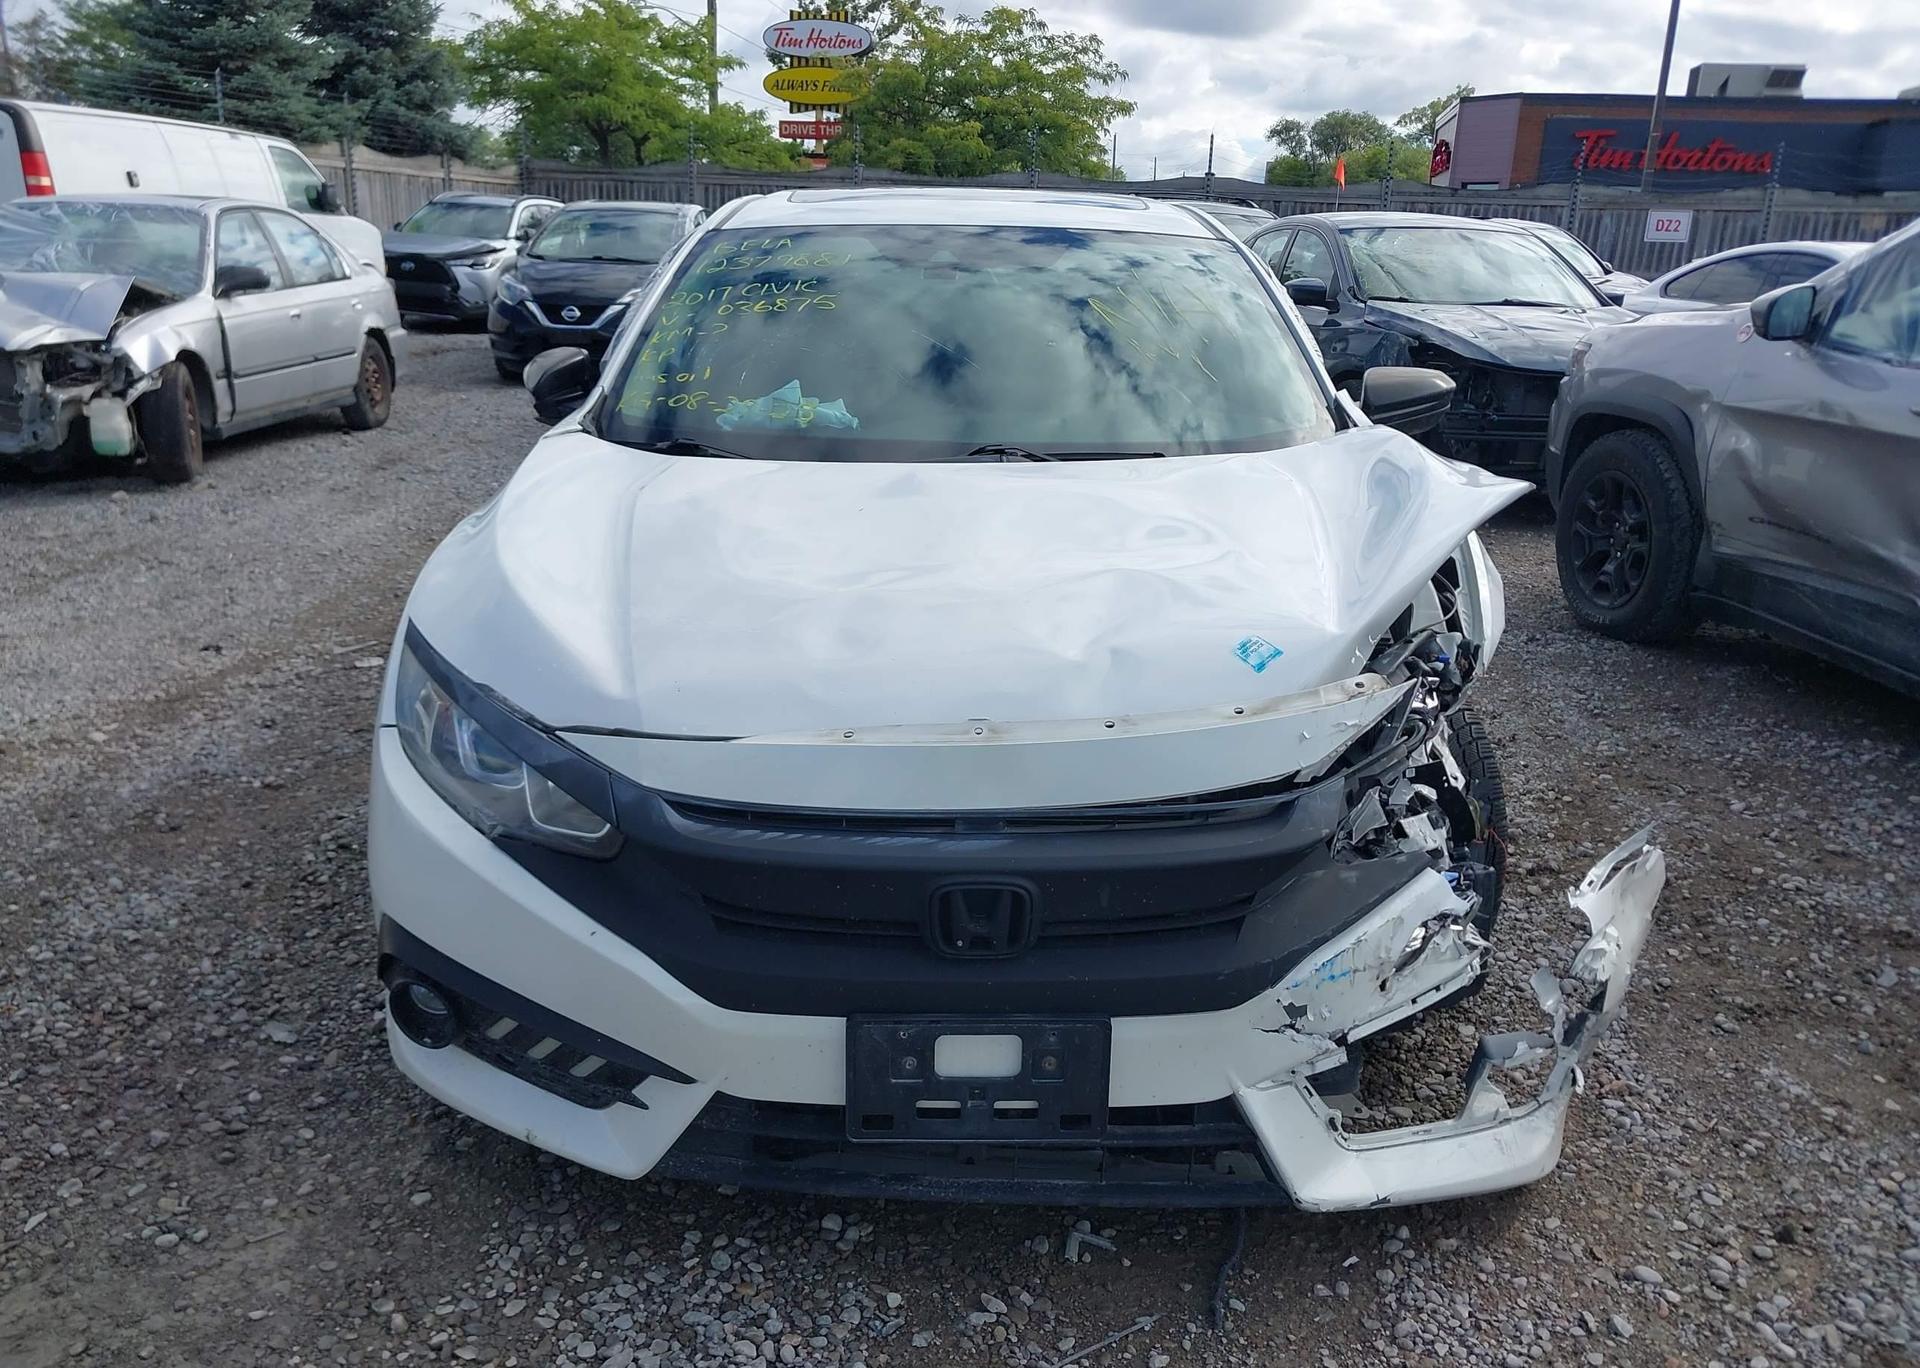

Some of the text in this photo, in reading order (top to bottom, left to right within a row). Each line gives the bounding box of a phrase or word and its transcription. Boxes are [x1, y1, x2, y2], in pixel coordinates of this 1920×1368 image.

[773, 27, 863, 50] Tim Hortons
[771, 79, 819, 92] ALWAYS
[782, 124, 842, 136] DRIVE THR
[1573, 128, 1634, 170] Tim
[1655, 217, 1682, 233] DZ2
[667, 279, 818, 308] 2017 CIVIC
